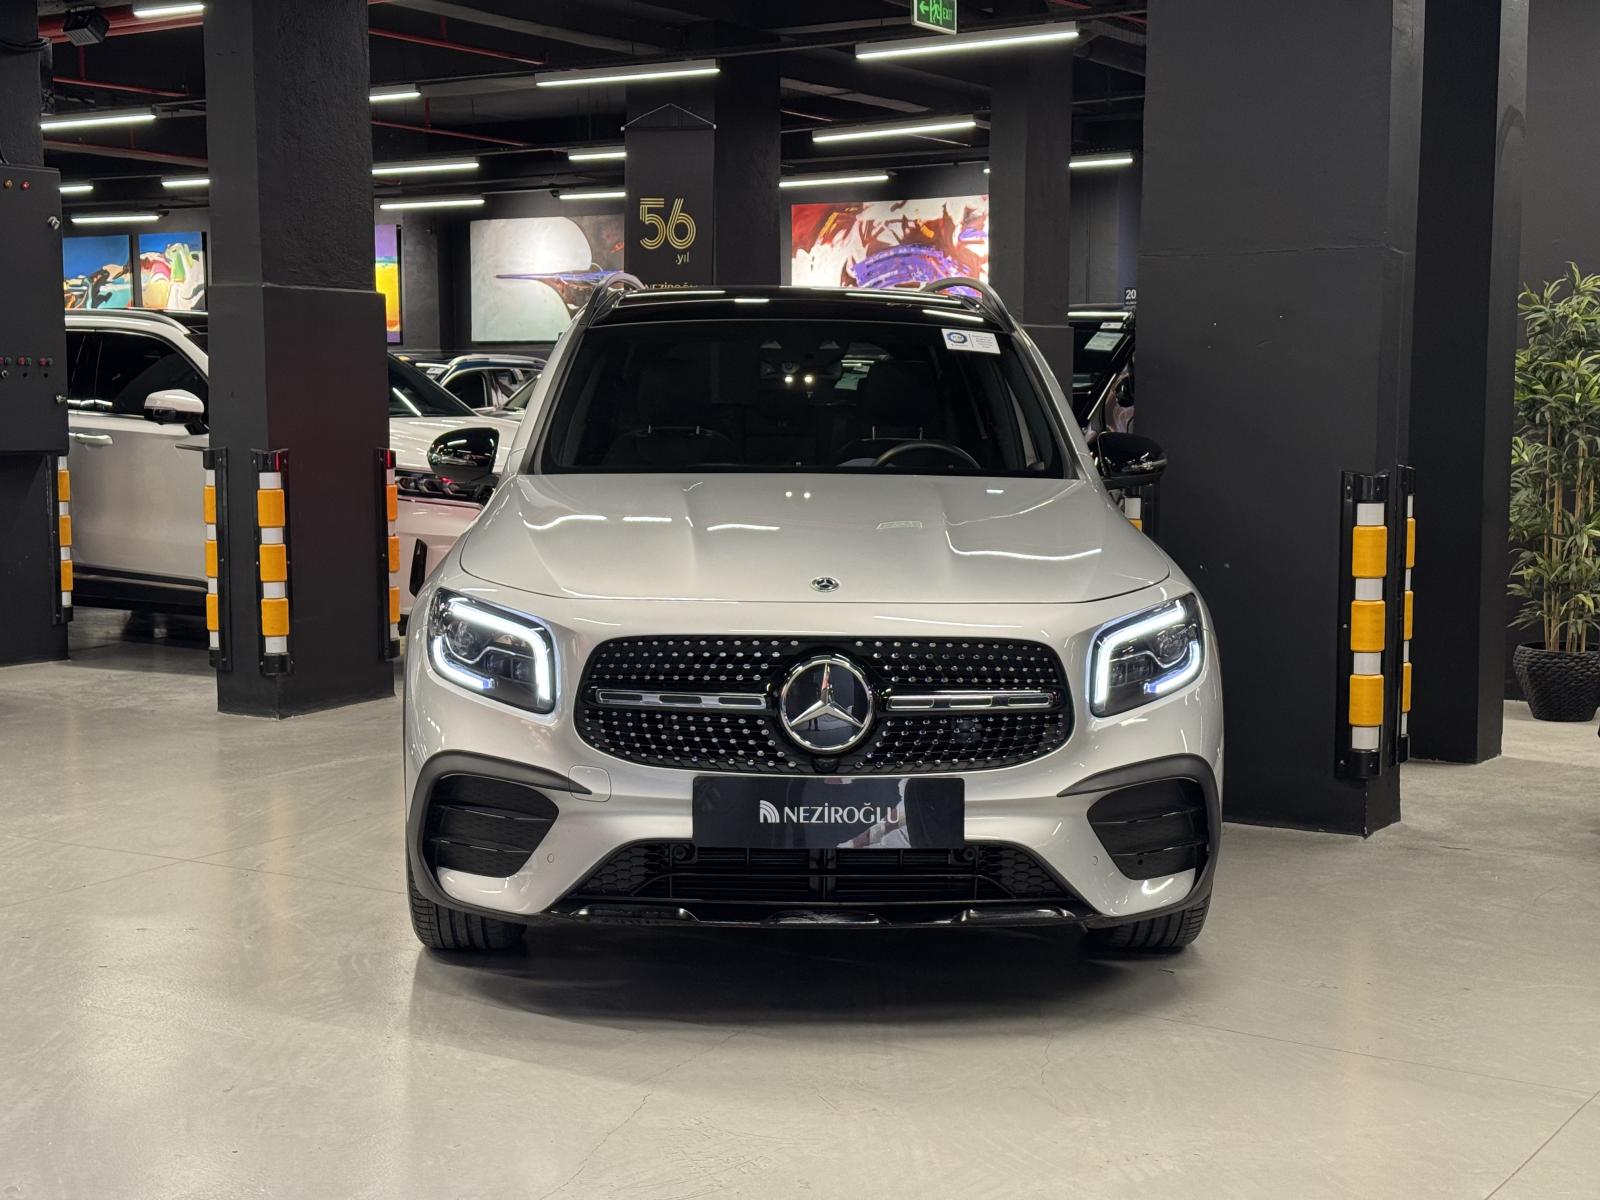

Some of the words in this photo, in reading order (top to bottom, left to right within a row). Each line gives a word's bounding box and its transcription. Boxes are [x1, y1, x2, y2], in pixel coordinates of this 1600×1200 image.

[943, 8, 953, 21] EXIT
[640, 198, 696, 250] 56
[784, 802, 900, 824] NEZİROĞLU
